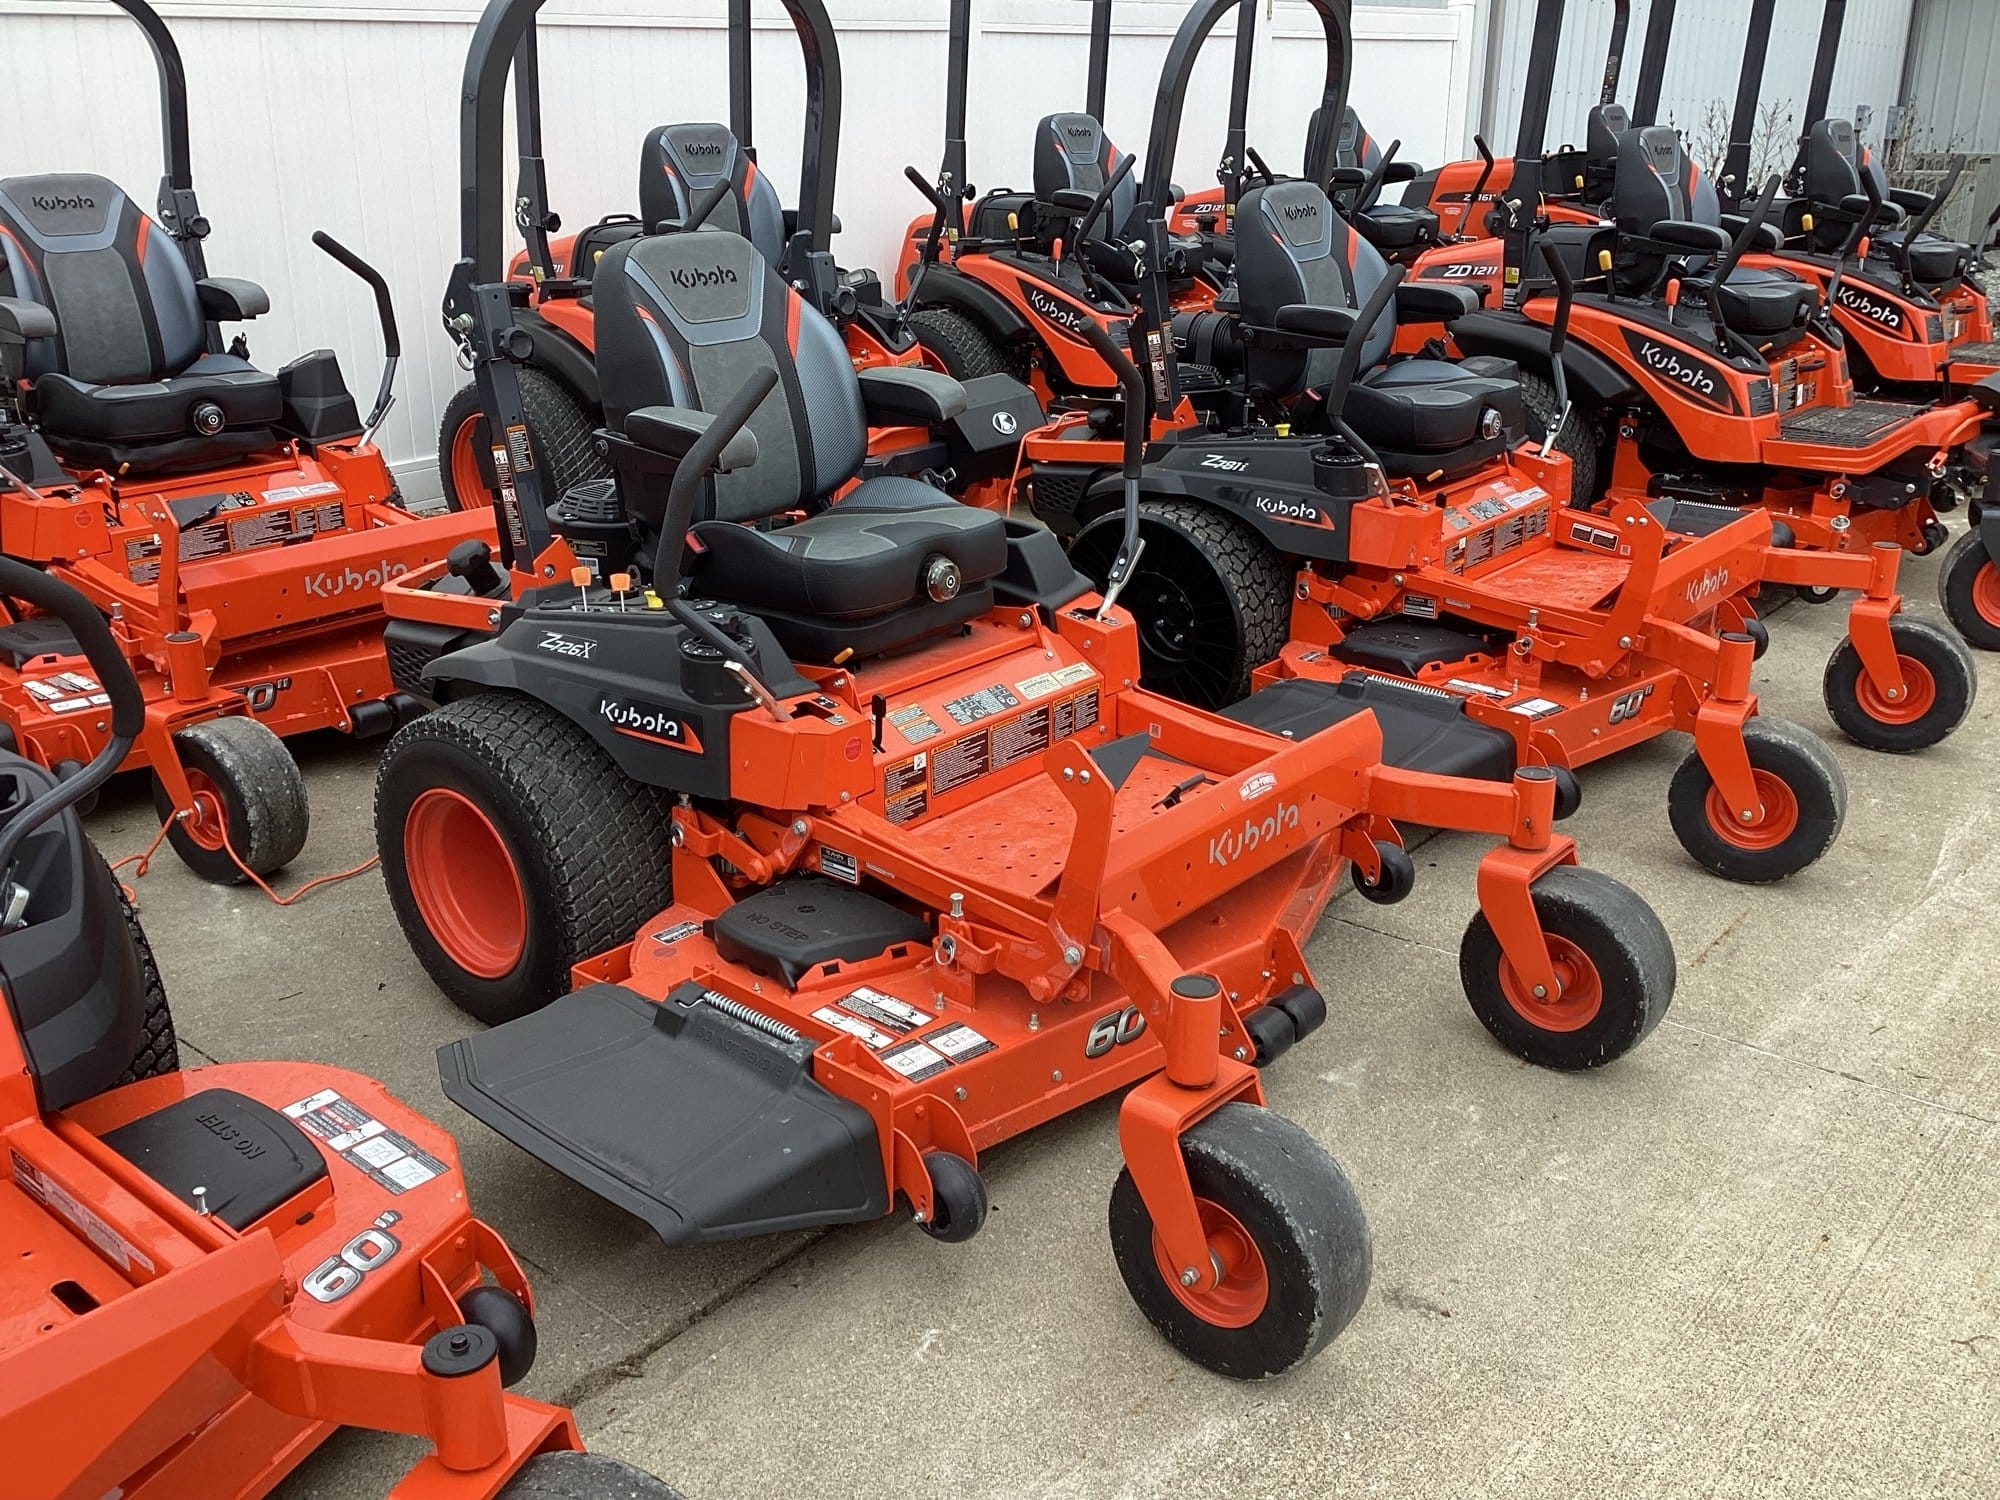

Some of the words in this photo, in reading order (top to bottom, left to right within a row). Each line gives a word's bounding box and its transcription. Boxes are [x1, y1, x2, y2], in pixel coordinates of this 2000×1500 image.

[1067, 127, 1091, 137] Kubota
[684, 143, 721, 156] Kubota
[32, 194, 95, 210] Kubota
[1283, 203, 1317, 220] Kubota
[669, 265, 738, 288] Kubota
[1031, 290, 1081, 332] Kubota
[1838, 286, 1899, 327] Kubota
[1641, 342, 1714, 394] Kubota
[1256, 497, 1316, 519] Kubota
[304, 560, 408, 597] Kubota
[1686, 565, 1728, 603] Kubota
[600, 699, 678, 737] Kubota
[1208, 802, 1299, 866] Kubota
[745, 912, 769, 925] NO
[769, 921, 810, 940] STEP
[195, 1114, 240, 1141] STEP
[234, 1139, 266, 1160] NO
